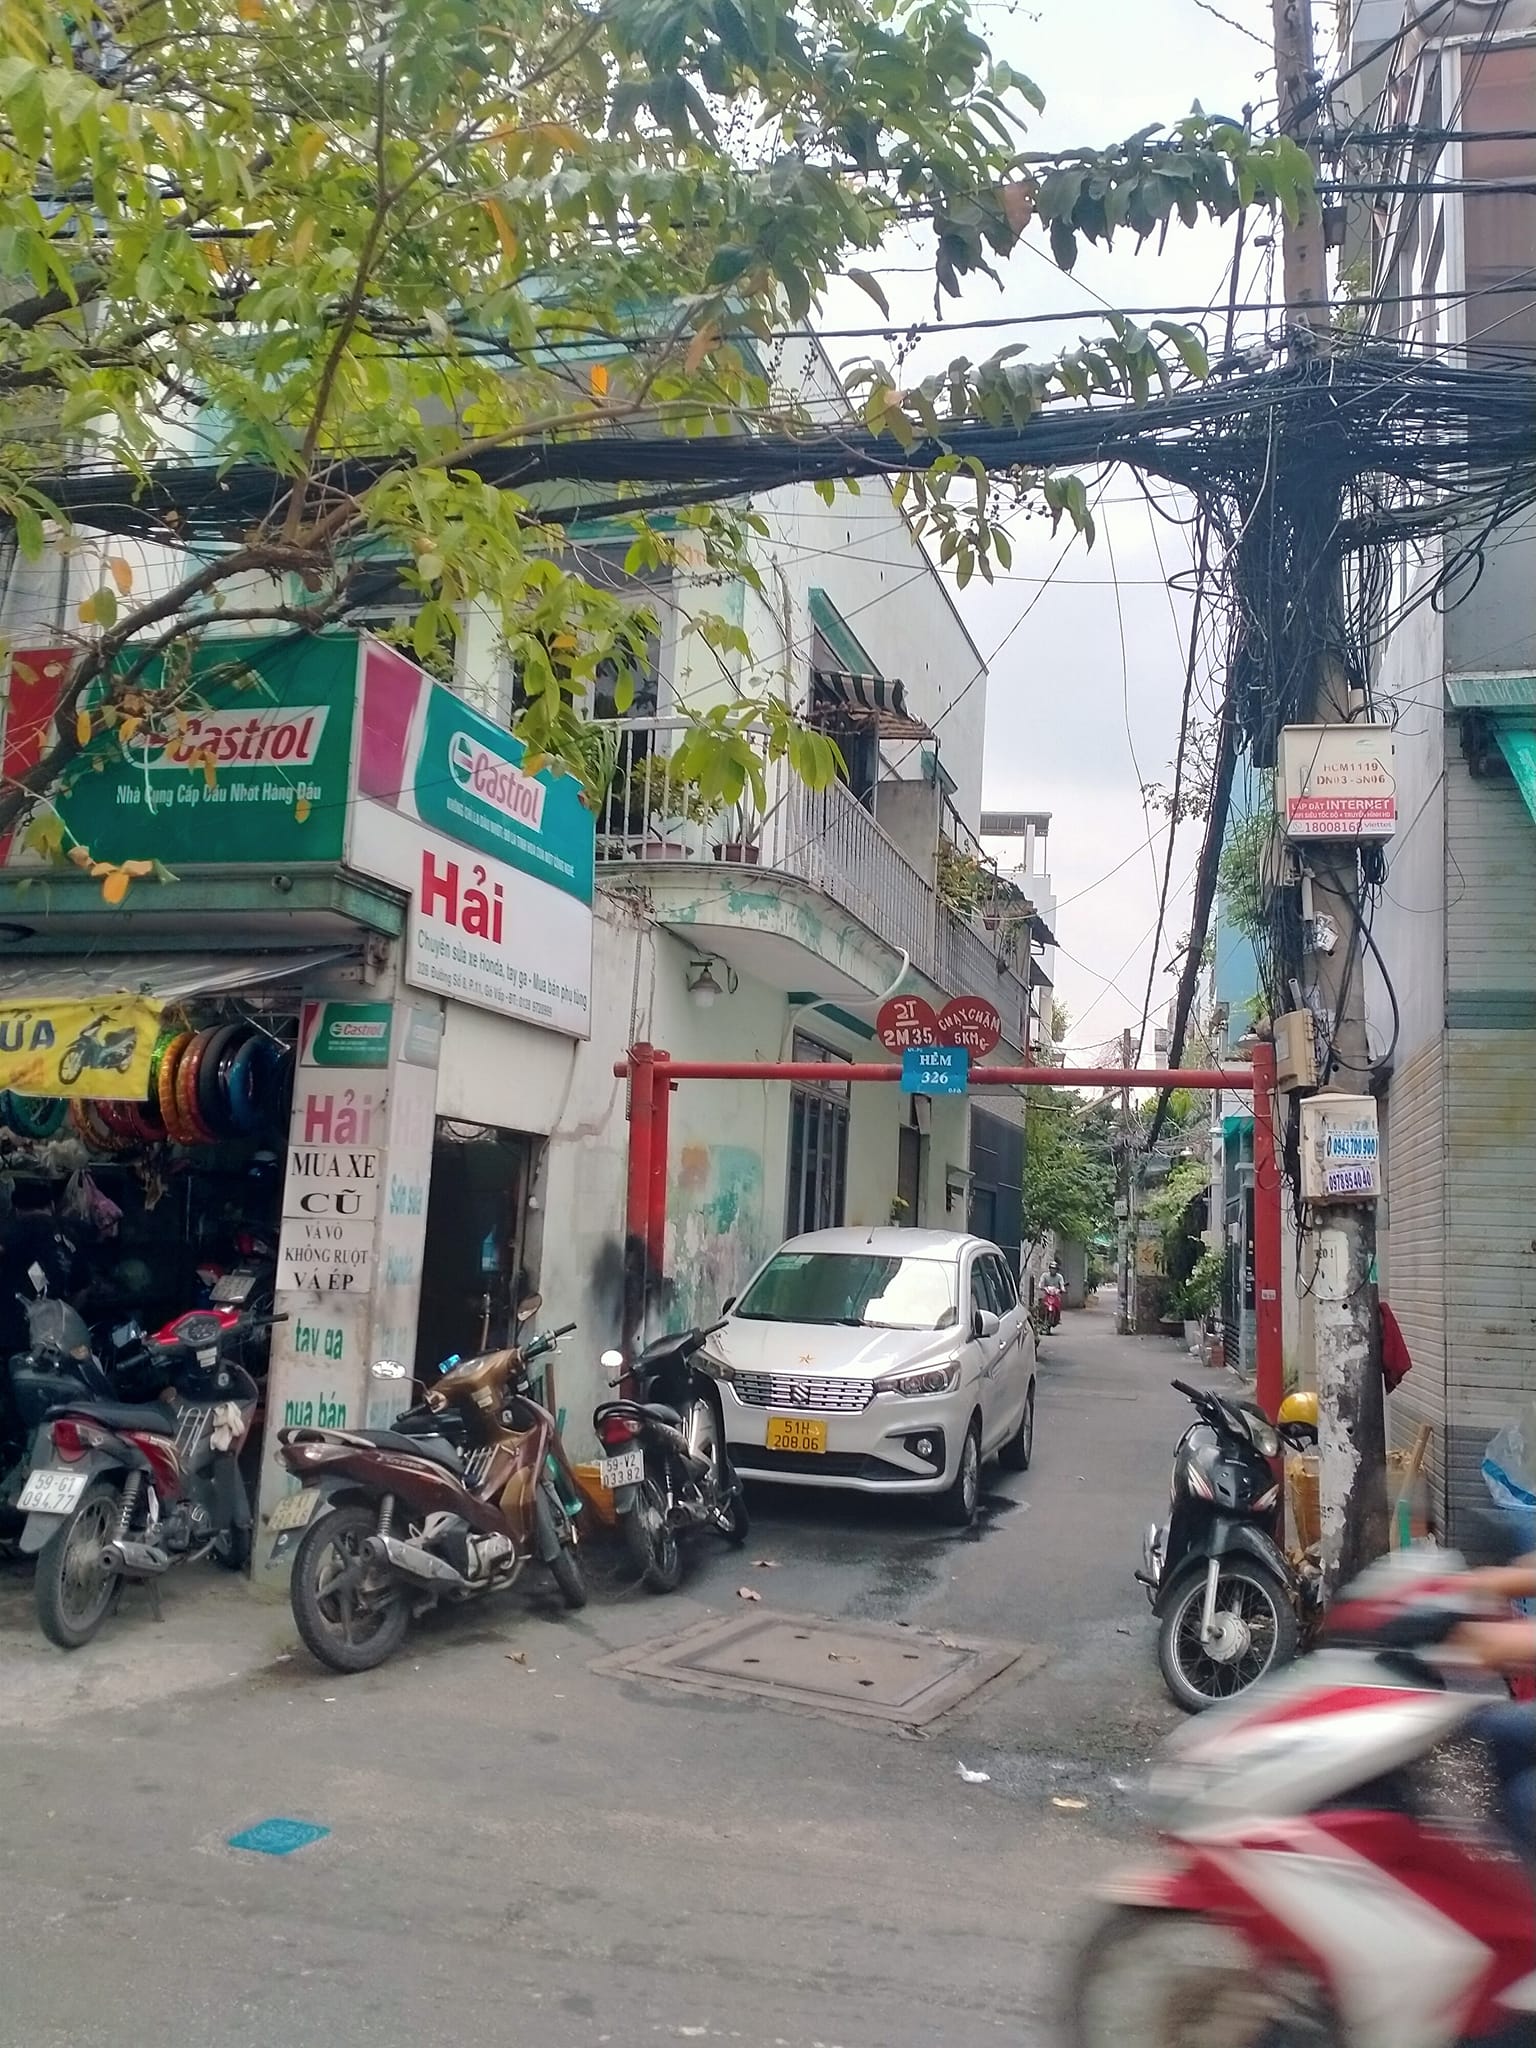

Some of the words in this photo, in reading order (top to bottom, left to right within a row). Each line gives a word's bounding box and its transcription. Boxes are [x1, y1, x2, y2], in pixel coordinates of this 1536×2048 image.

[172, 717, 315, 762] Castrol
[1323, 762, 1378, 772] HCM1119
[116, 785, 141, 804] Nhà
[177, 783, 200, 807] Cấp
[262, 783, 293, 805] Hàng
[473, 752, 538, 824] Castrol
[1308, 803, 1324, 811] ĐẶT
[1326, 800, 1390, 810] INTERNET
[421, 849, 504, 944] Hải
[893, 1000, 918, 1020] 2T
[919, 1051, 952, 1066] HẺM
[920, 1071, 949, 1084] 326
[304, 1089, 373, 1145] Hải
[291, 1152, 340, 1177] MUA
[347, 1154, 376, 1178] XE
[300, 1188, 362, 1215] CŨ
[284, 1243, 330, 1263] KHÔNG
[294, 1267, 321, 1290] VÁ
[328, 1268, 354, 1290] ÉP
[318, 1392, 346, 1428] bán
[784, 1420, 810, 1435] 51H
[774, 1434, 819, 1450] 208.06
[22, 1491, 75, 1511] 094.77
